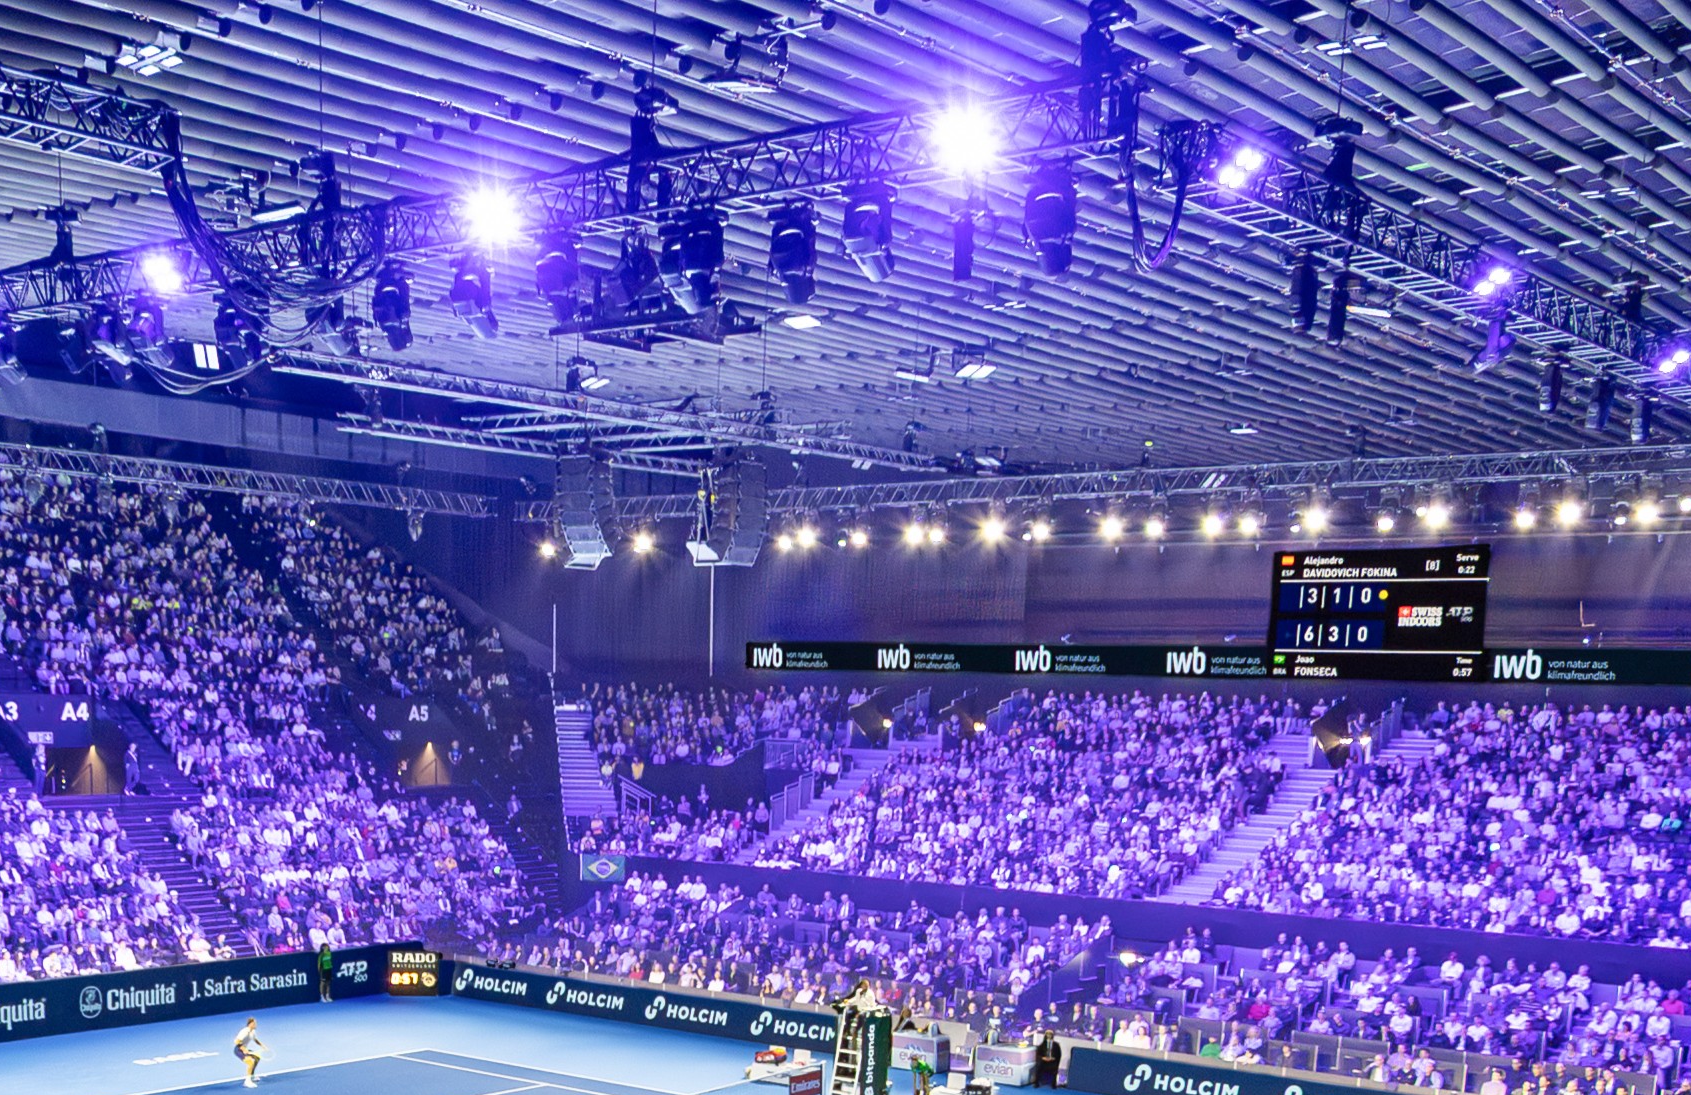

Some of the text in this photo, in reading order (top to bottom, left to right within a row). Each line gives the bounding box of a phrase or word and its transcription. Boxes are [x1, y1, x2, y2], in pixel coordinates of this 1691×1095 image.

[1304, 556, 1344, 566] Alejandro
[1303, 568, 1397, 578] DAVIDOVICH FOKINA
[1308, 588, 1372, 604] 3 1 0
[1412, 606, 1443, 617] SWISS
[1398, 616, 1442, 627] INDOORS
[1304, 626, 1368, 642] 6 3 0
[1069, 654, 1087, 662] natur
[1088, 655, 1100, 663] aus
[1211, 656, 1260, 665] von natur aus
[1055, 664, 1106, 672] klimafreundlich
[1210, 664, 1267, 676] klimafreundlich
[1548, 660, 1608, 670] von natur aus
[1294, 667, 1338, 677] FONSECA
[1452, 668, 1472, 677] 0:57
[1547, 669, 1616, 681] klimafreundlich
[60, 702, 90, 722] A4
[408, 704, 428, 722] A5
[392, 952, 436, 964] RADO
[336, 960, 368, 978] ATP
[354, 973, 368, 983] 500
[190, 969, 308, 1002] J. Safra Sarasin
[474, 976, 528, 996] HOLCIM
[106, 984, 176, 1014] Chiquita
[566, 989, 624, 1011] HOLCIM
[666, 1004, 728, 1026] HOLCIM
[866, 1024, 876, 1084] bitpanda
[984, 1064, 1014, 1076] evian
[791, 1080, 821, 1094] Emirates
